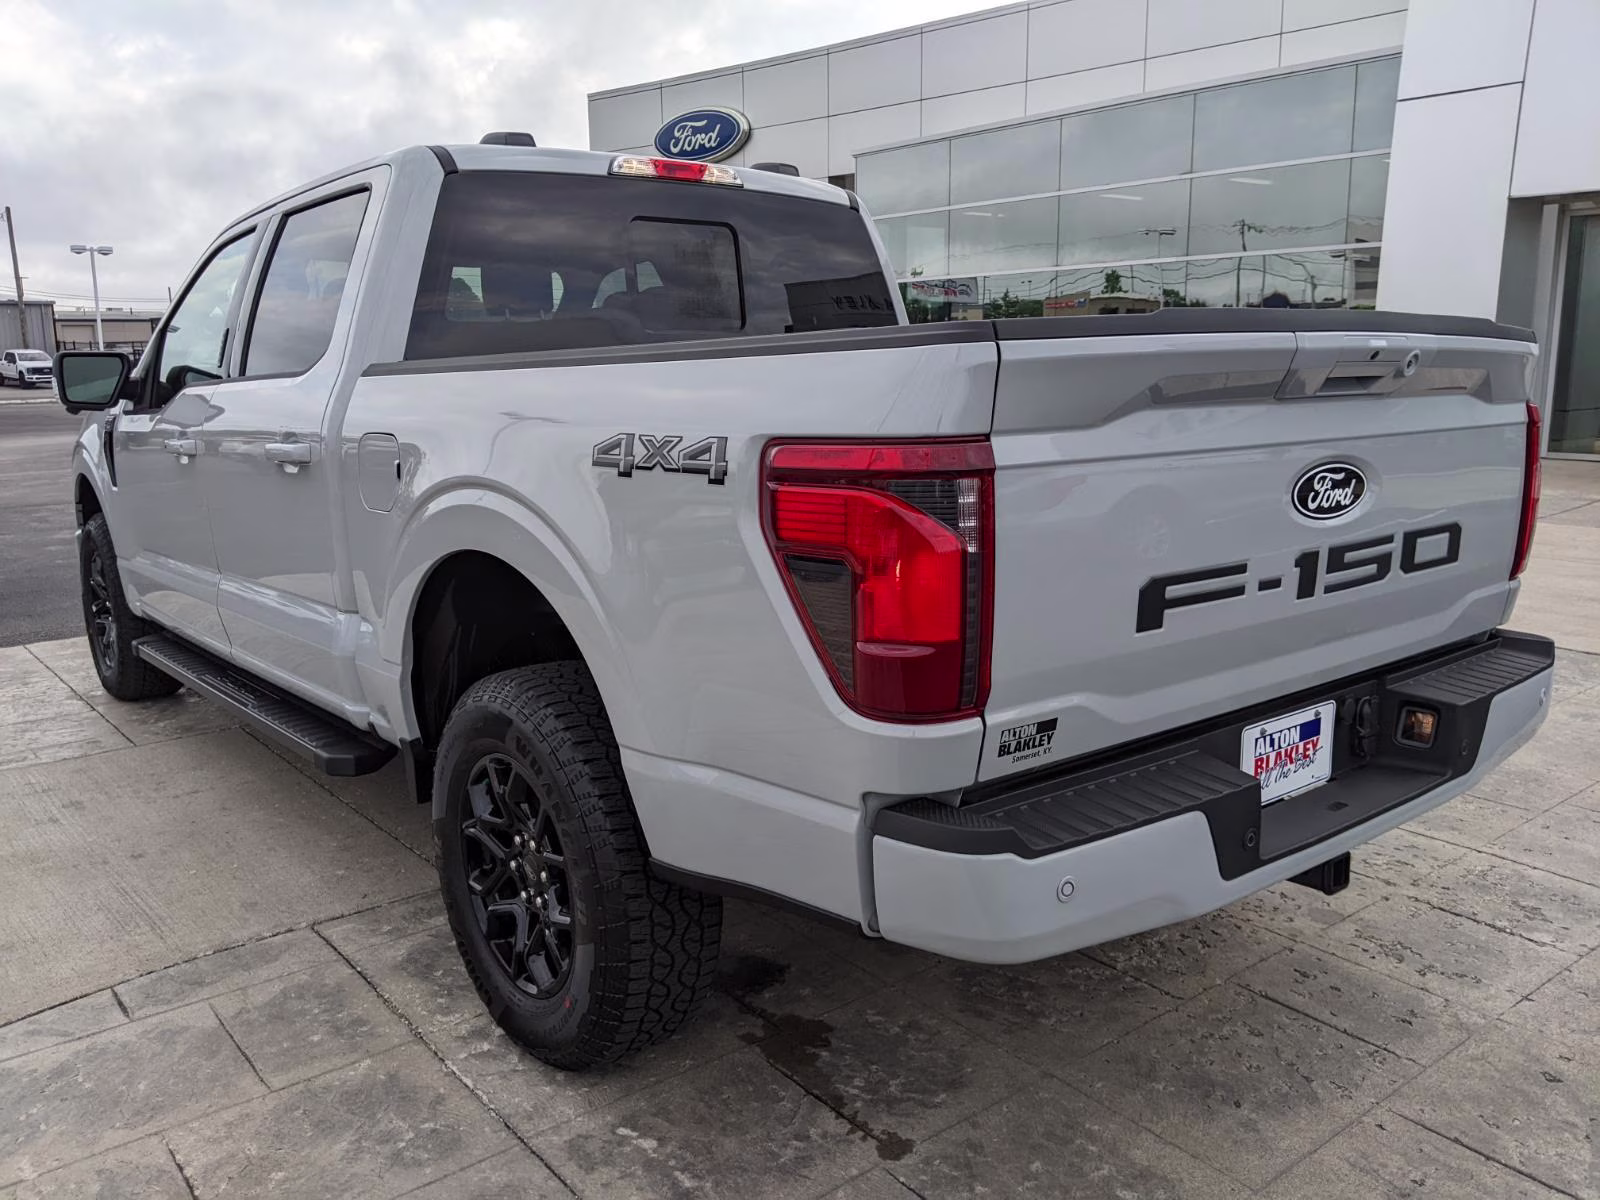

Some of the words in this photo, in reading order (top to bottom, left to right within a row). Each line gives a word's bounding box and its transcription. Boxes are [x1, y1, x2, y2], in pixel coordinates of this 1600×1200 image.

[670, 119, 721, 154] Ford
[1308, 472, 1355, 510] Ford
[1136, 521, 1462, 634] F-150
[998, 732, 1054, 758] BLAKLEY
[1000, 723, 1038, 743] ALTON
[1254, 725, 1300, 756] ALTON
[1254, 736, 1320, 780] BLAKLEY
